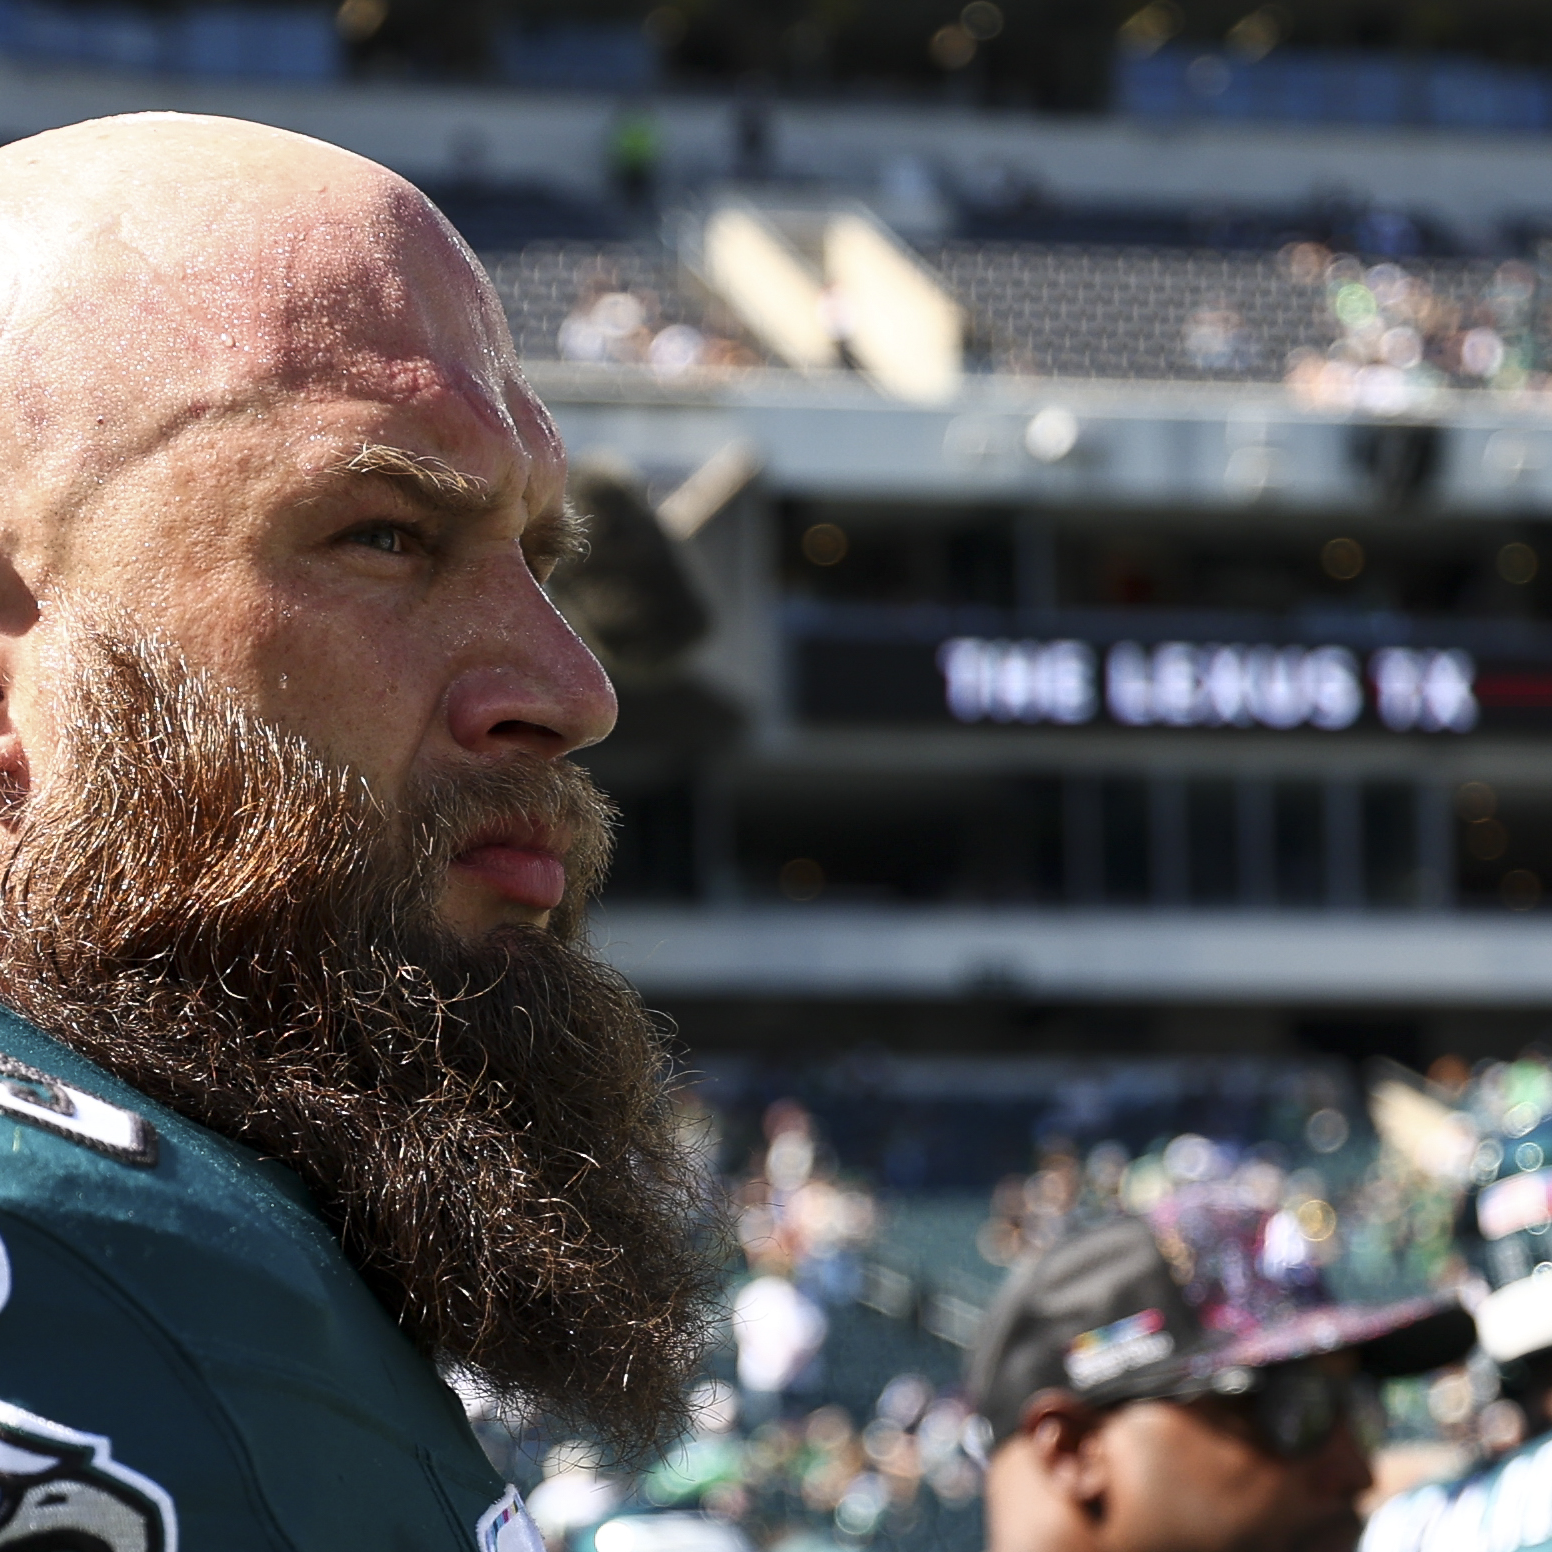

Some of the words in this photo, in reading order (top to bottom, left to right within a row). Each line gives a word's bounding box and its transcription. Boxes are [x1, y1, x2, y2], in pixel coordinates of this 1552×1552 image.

[938, 638, 1096, 724] THE
[1107, 640, 1361, 730] LEXUS
[1370, 646, 1479, 732] TX
